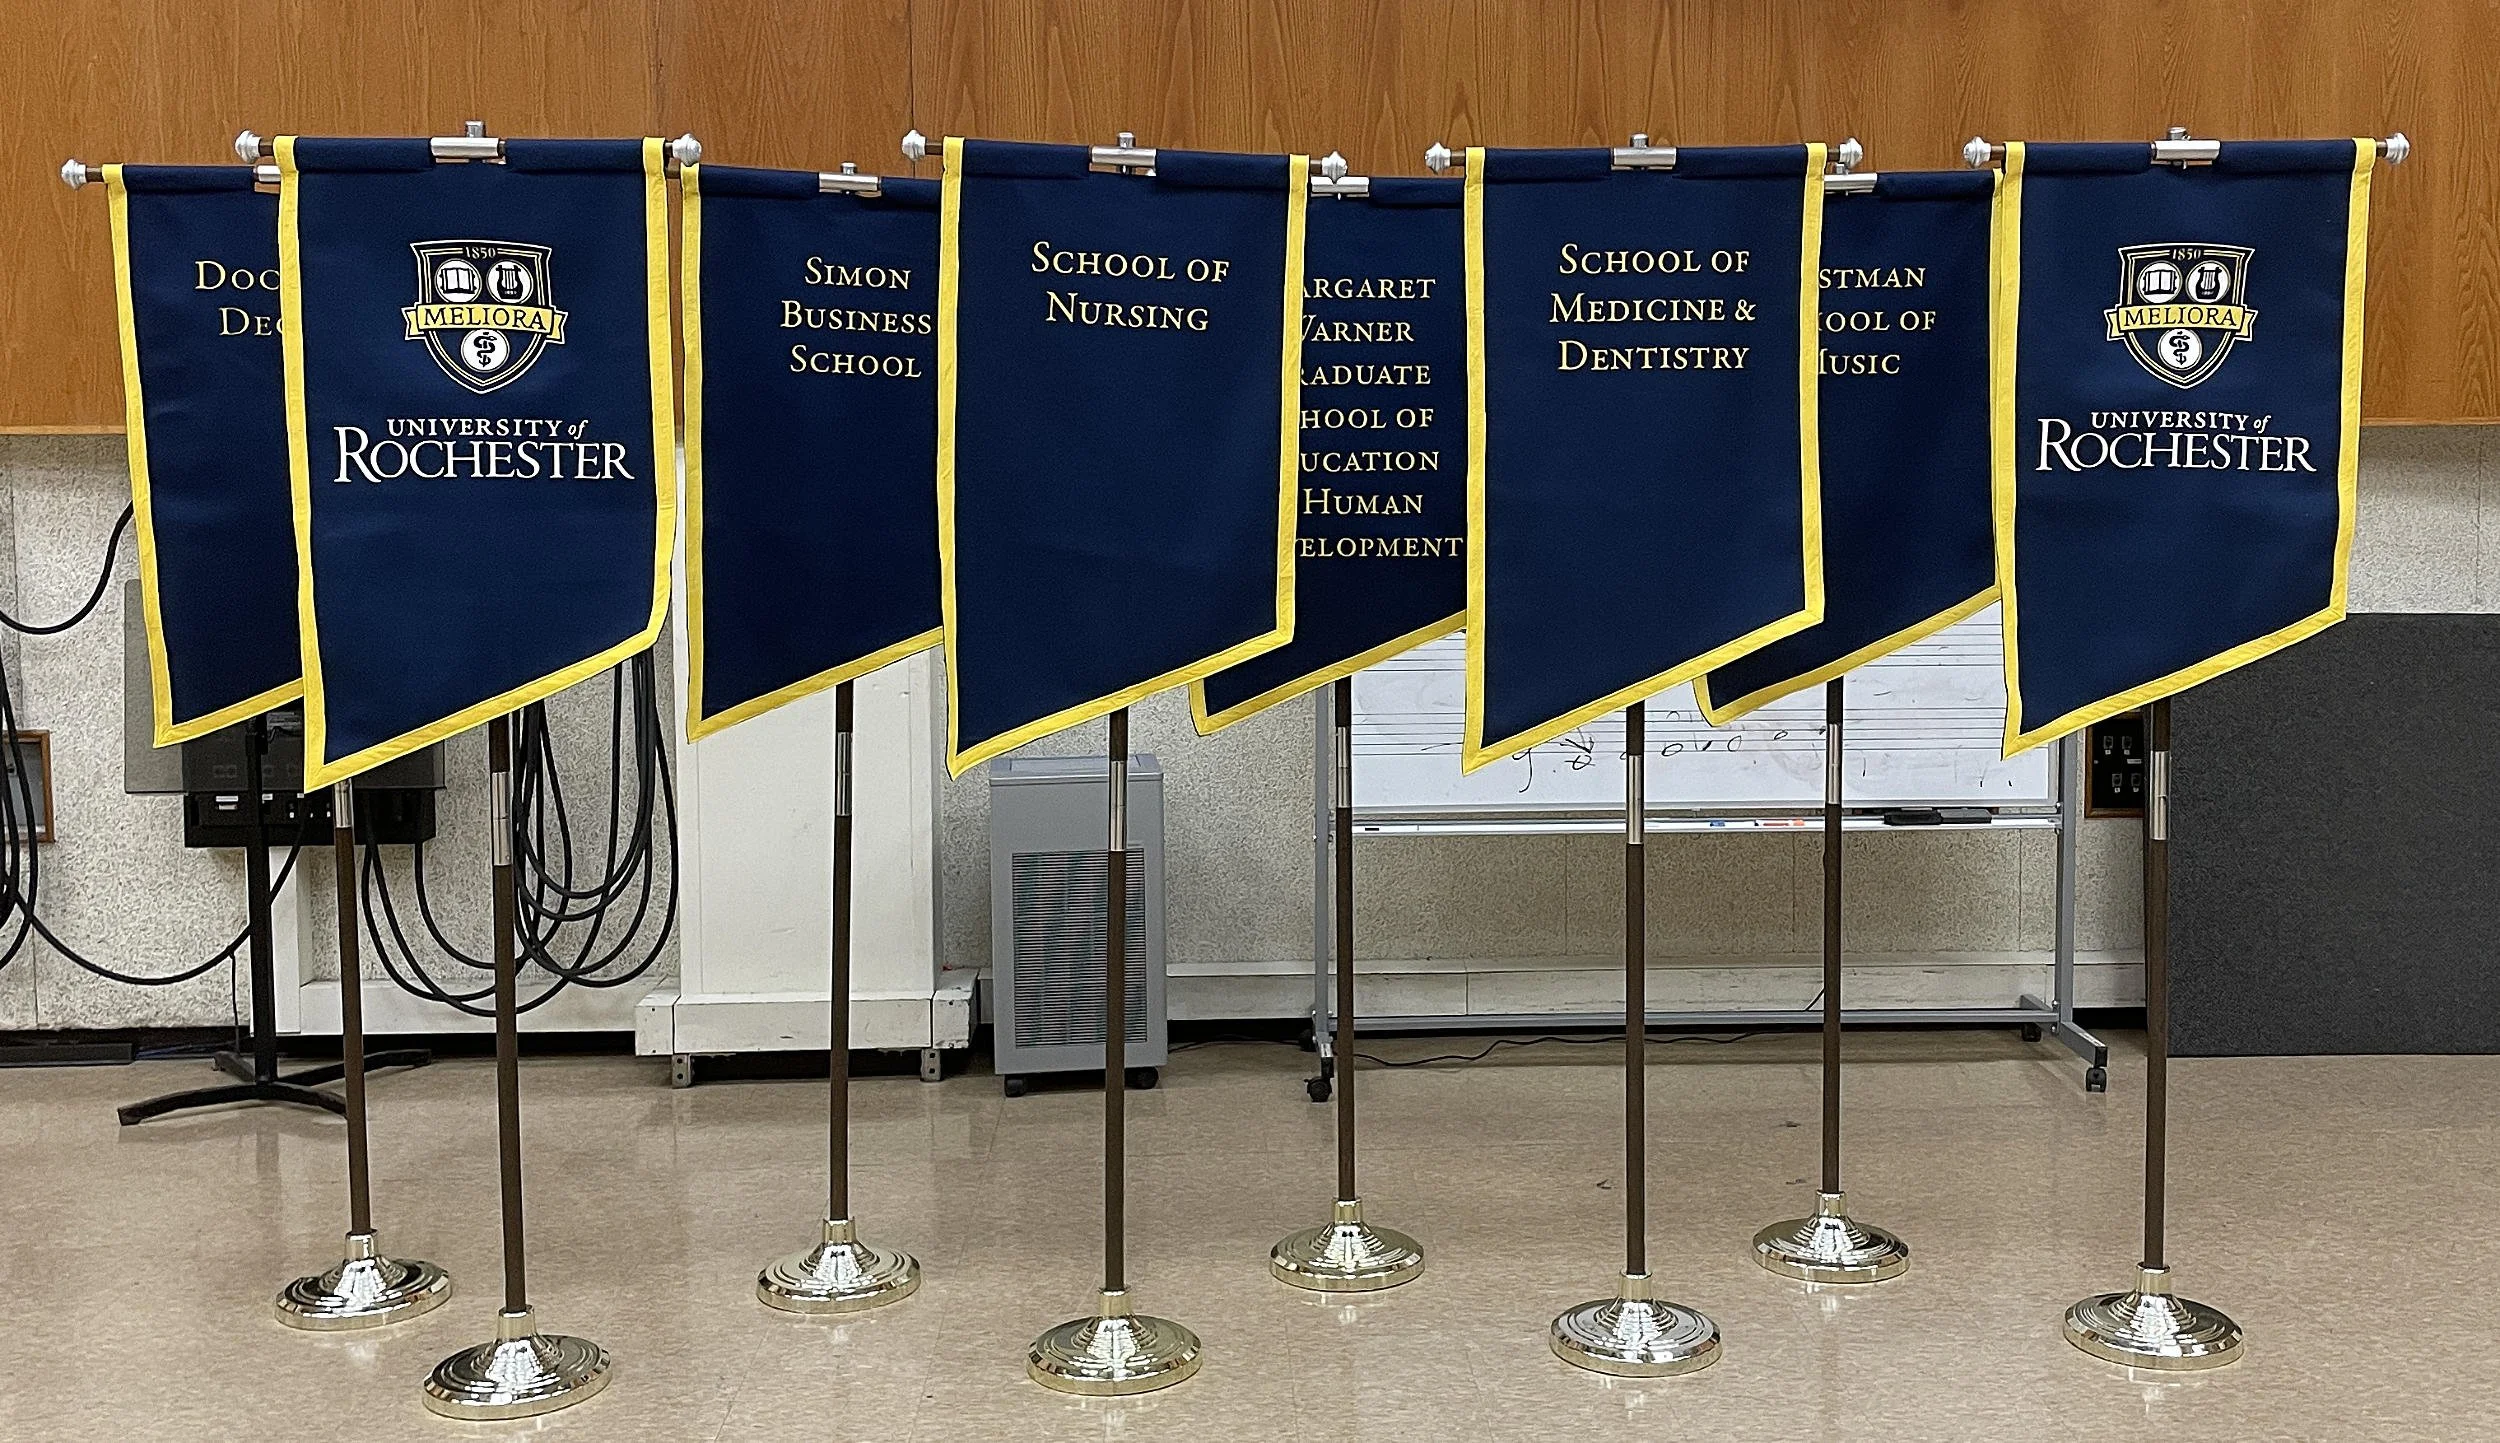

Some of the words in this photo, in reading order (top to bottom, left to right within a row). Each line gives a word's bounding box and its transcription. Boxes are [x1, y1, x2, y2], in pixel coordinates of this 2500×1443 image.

[465, 246, 497, 260] 1850
[1031, 241, 1176, 280] SCHOOL
[1187, 258, 1230, 283] OF
[1560, 243, 1702, 275] SCHOOL
[1711, 250, 1750, 273] OF
[2172, 248, 2202, 261] 1850
[195, 260, 280, 290] DOC
[804, 256, 912, 290] SIMON
[1819, 268, 1926, 289] STMAN
[219, 307, 282, 336] DE
[424, 306, 547, 330] MELIORA
[780, 300, 932, 335] BUSINESS
[1046, 290, 1209, 331] NURSING
[1549, 293, 1726, 323] MEDICINE
[1734, 299, 1757, 321] &
[1819, 311, 1890, 332] OOL
[1900, 311, 1936, 331] OF
[2123, 306, 2238, 327] MELIORA
[790, 345, 922, 378] SCHOOL
[1558, 340, 1750, 371] DENTISTRY
[387, 418, 562, 437] UNIVERSITY
[567, 419, 589, 440] of
[1300, 408, 1387, 429] HOOL
[1396, 408, 1434, 428] OF
[2091, 411, 2249, 432] UNIVERSITY
[2253, 415, 2272, 434] of
[333, 426, 635, 483] ROCHESTER
[2035, 418, 2317, 472] ROCHESTER
[1300, 451, 1440, 472] UCATION
[1303, 488, 1424, 515] HUMAN
[1296, 537, 1464, 557] ELOPMENT
